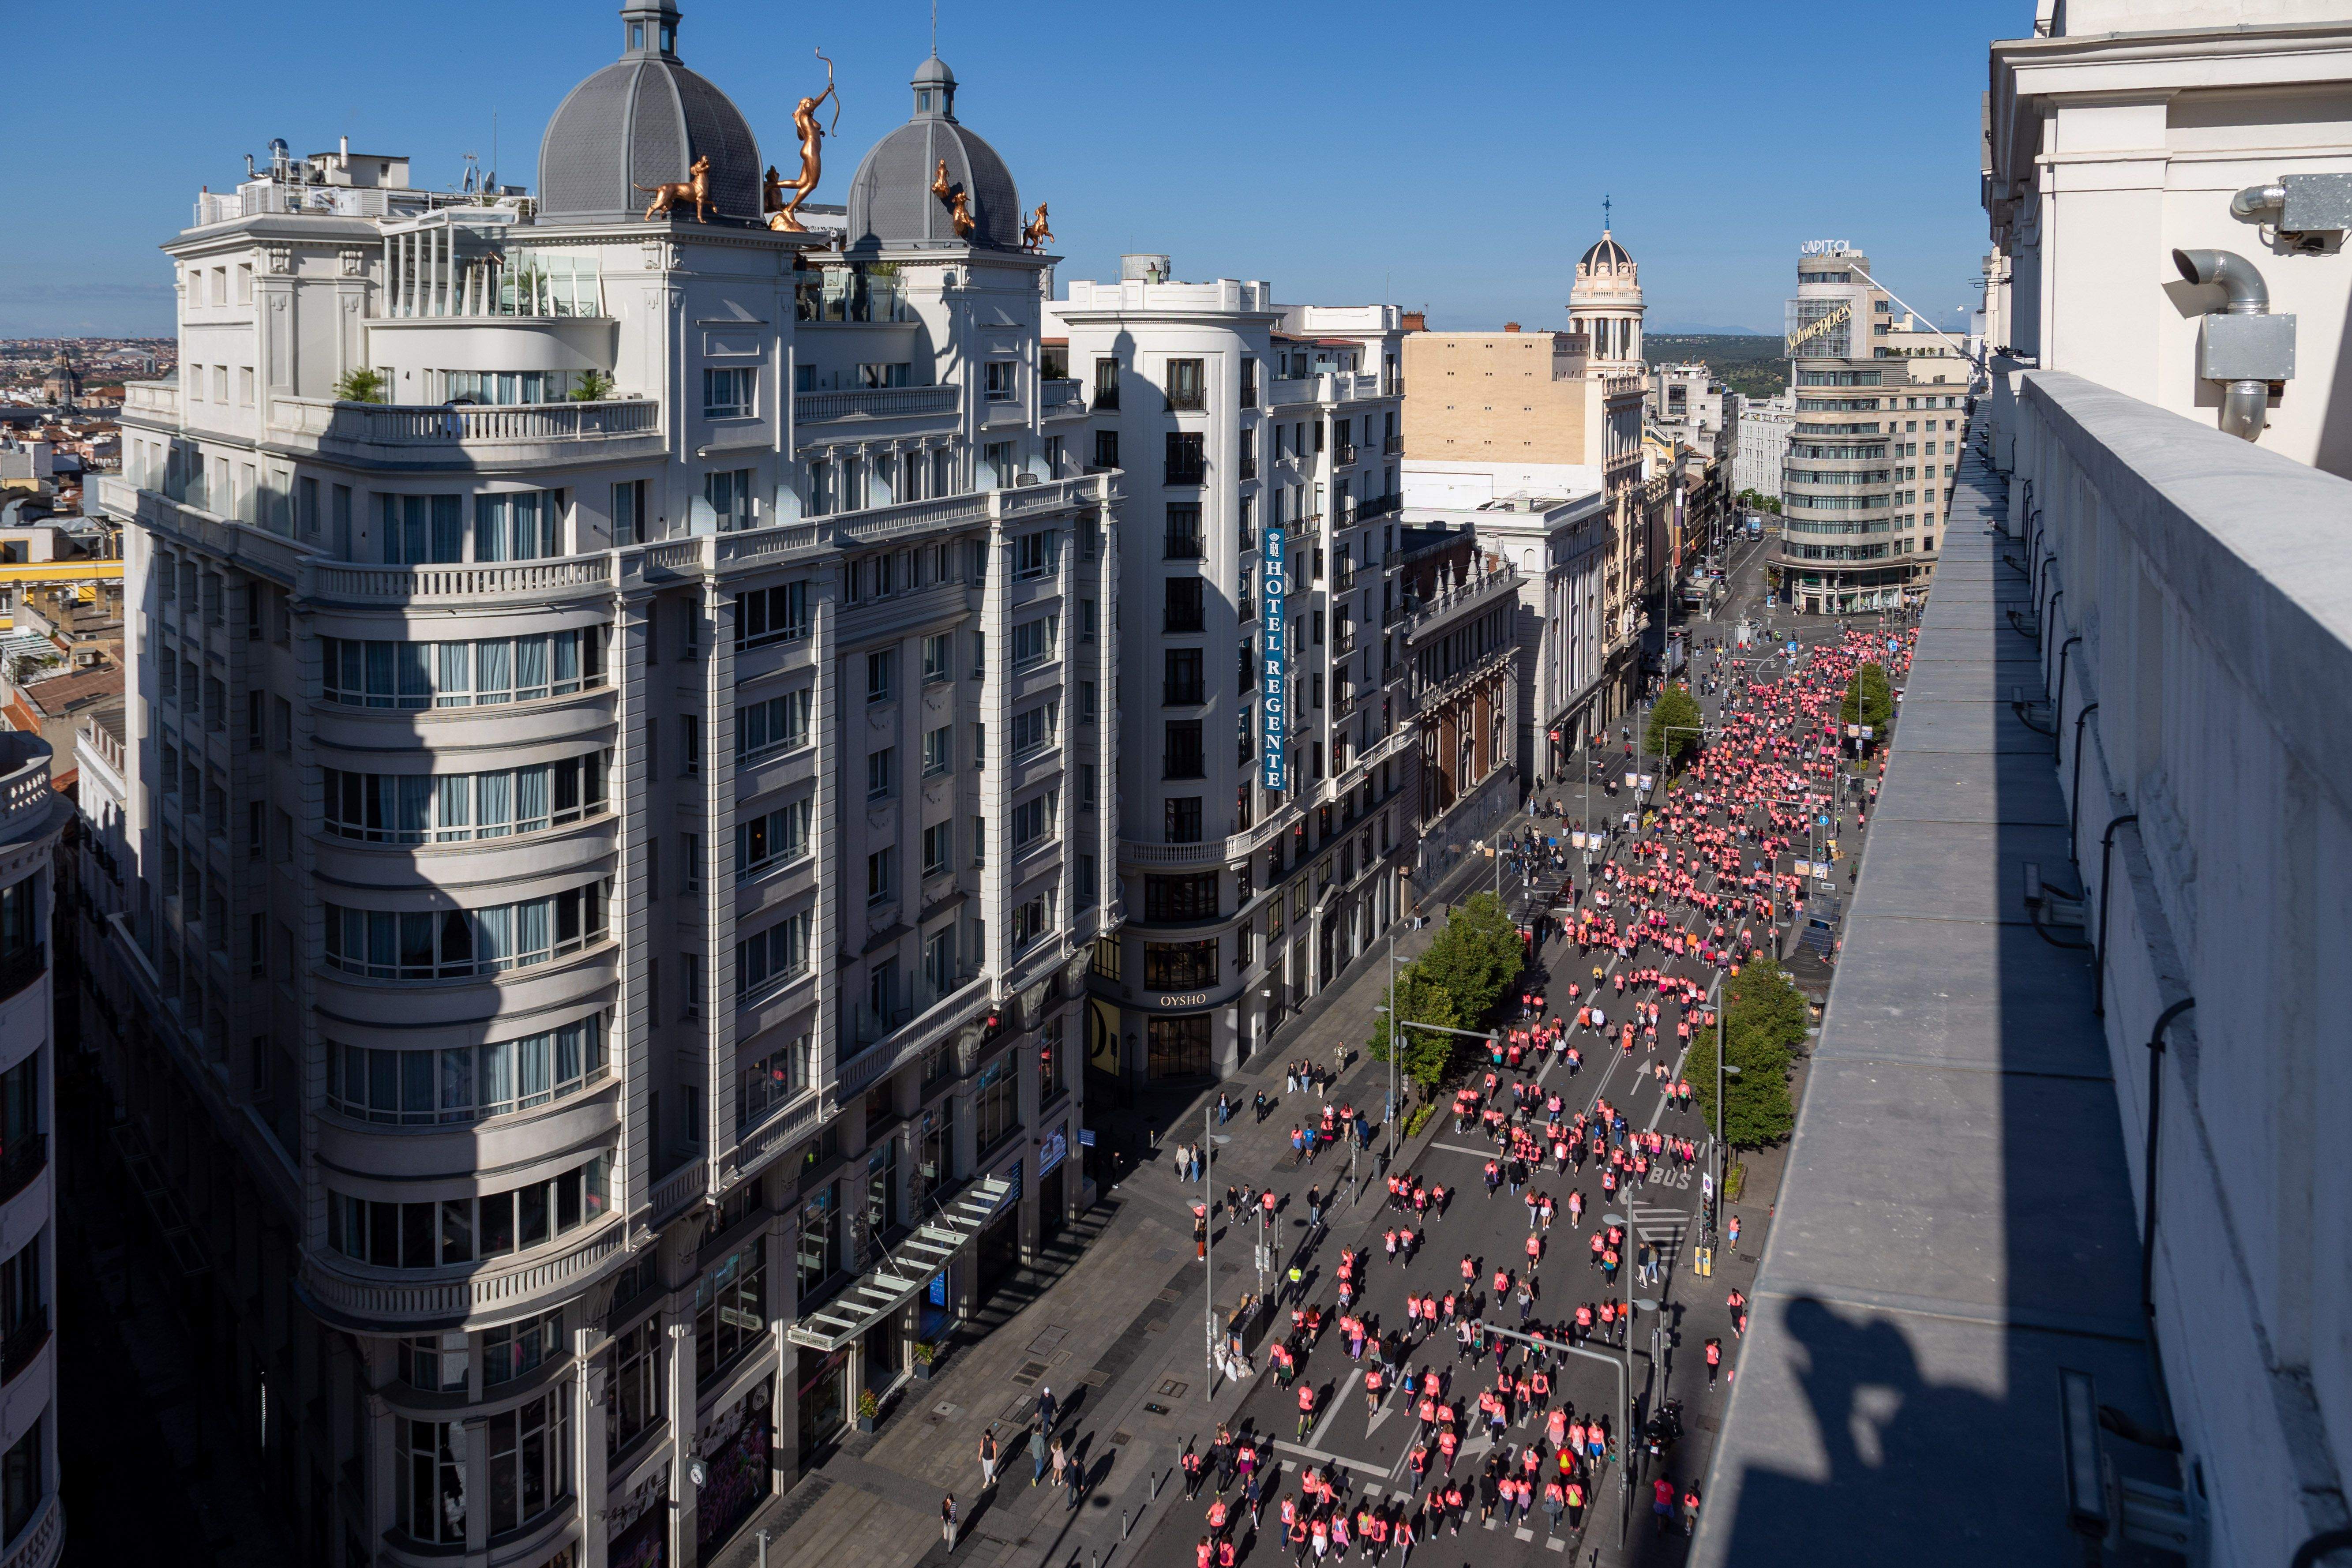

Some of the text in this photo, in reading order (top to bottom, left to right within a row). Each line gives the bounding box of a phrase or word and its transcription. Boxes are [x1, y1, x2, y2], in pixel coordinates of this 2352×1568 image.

[1787, 303, 1852, 353] Schweppes
[1266, 562, 1282, 650] HOTEL
[1266, 660, 1281, 787] REGENTE
[1160, 994, 1206, 1006] OYSHO
[1649, 1167, 1692, 1189] BUS
